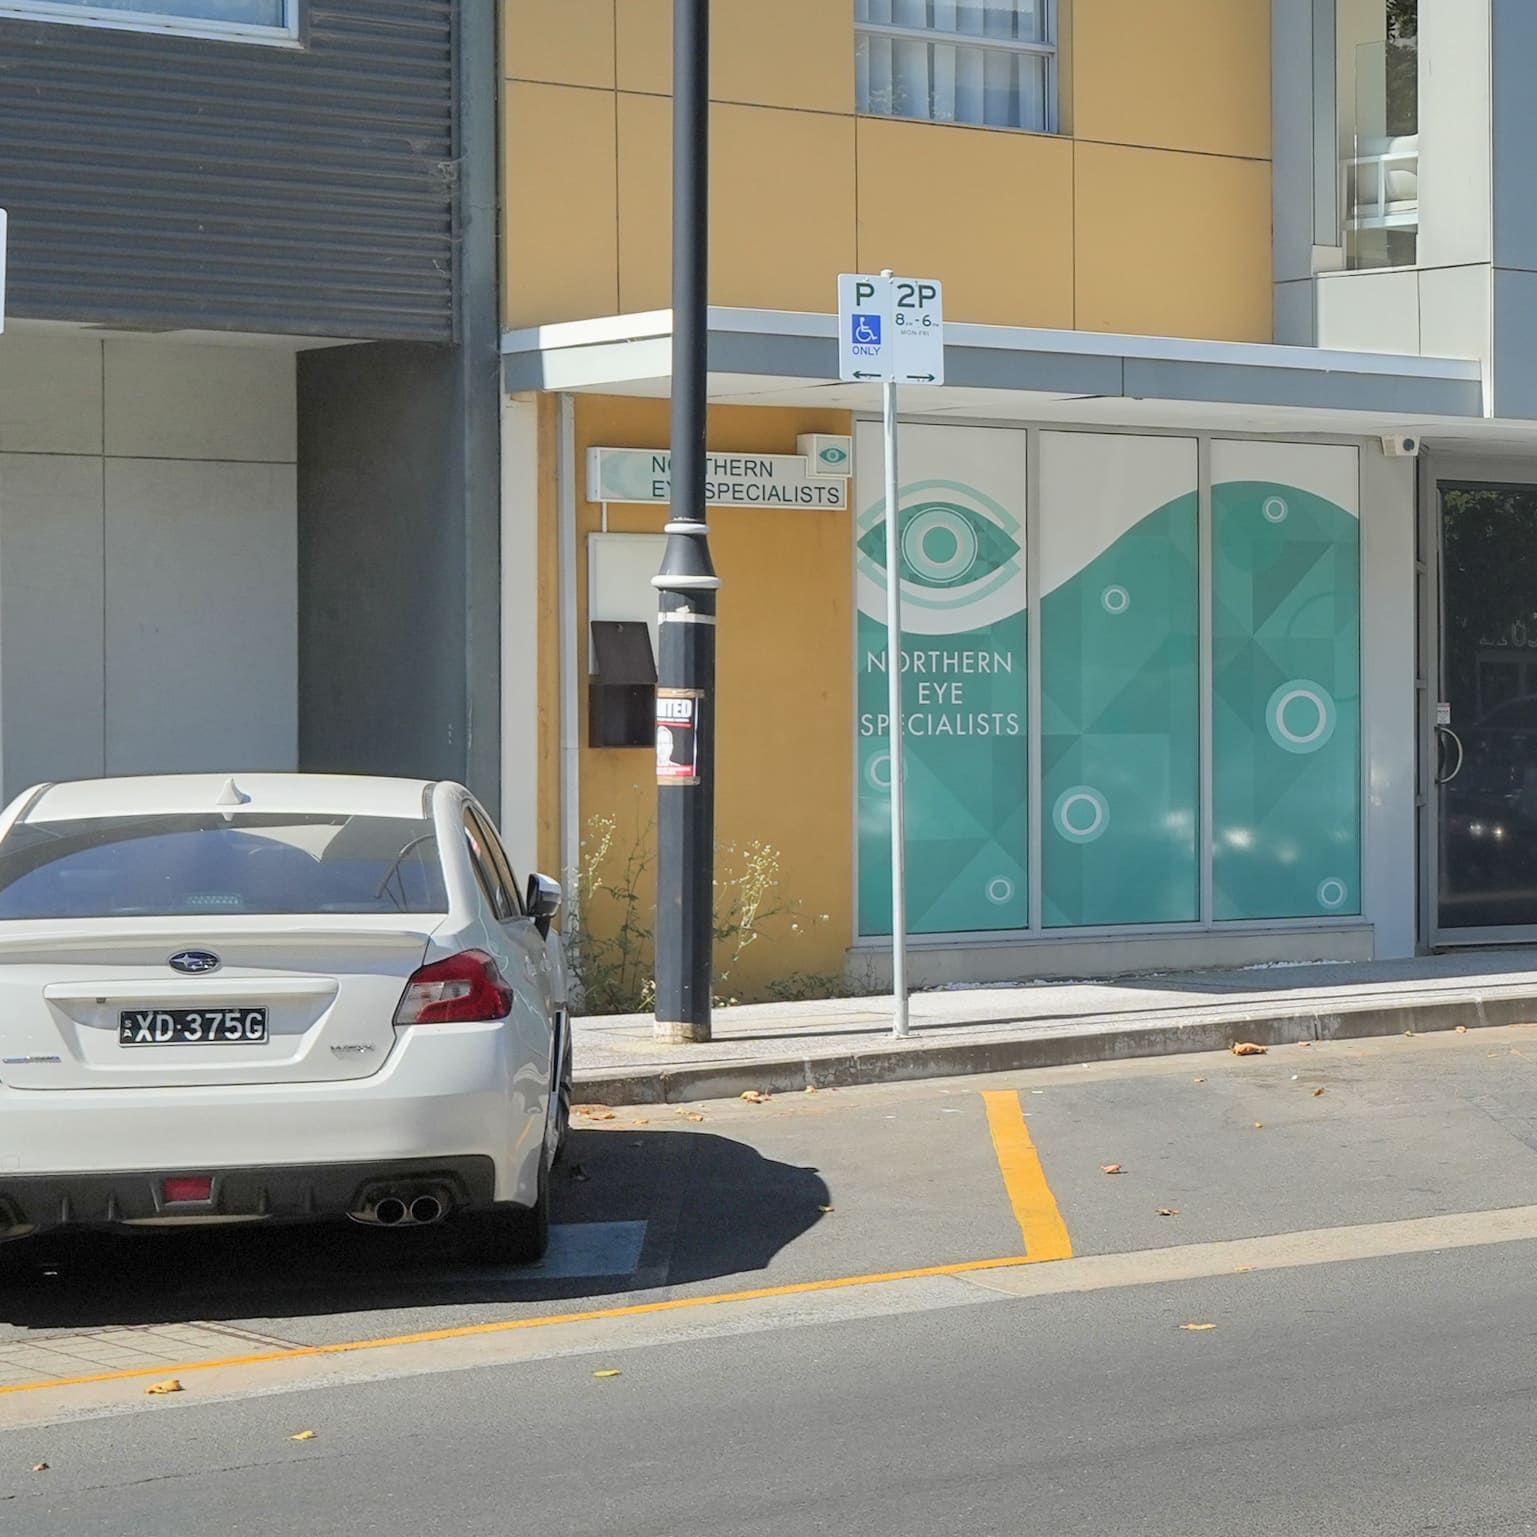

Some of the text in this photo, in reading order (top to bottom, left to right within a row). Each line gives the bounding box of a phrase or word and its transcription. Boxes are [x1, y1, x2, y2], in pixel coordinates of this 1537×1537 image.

[855, 282, 875, 307] P
[896, 283, 937, 309] 2P
[851, 345, 881, 356] ONLY
[652, 455, 774, 478] NHERN
[704, 482, 840, 505] SPECIALISTS
[867, 650, 1013, 673] NORTHERN
[918, 682, 964, 705] EYE
[860, 713, 1020, 737] SPCIALISTS
